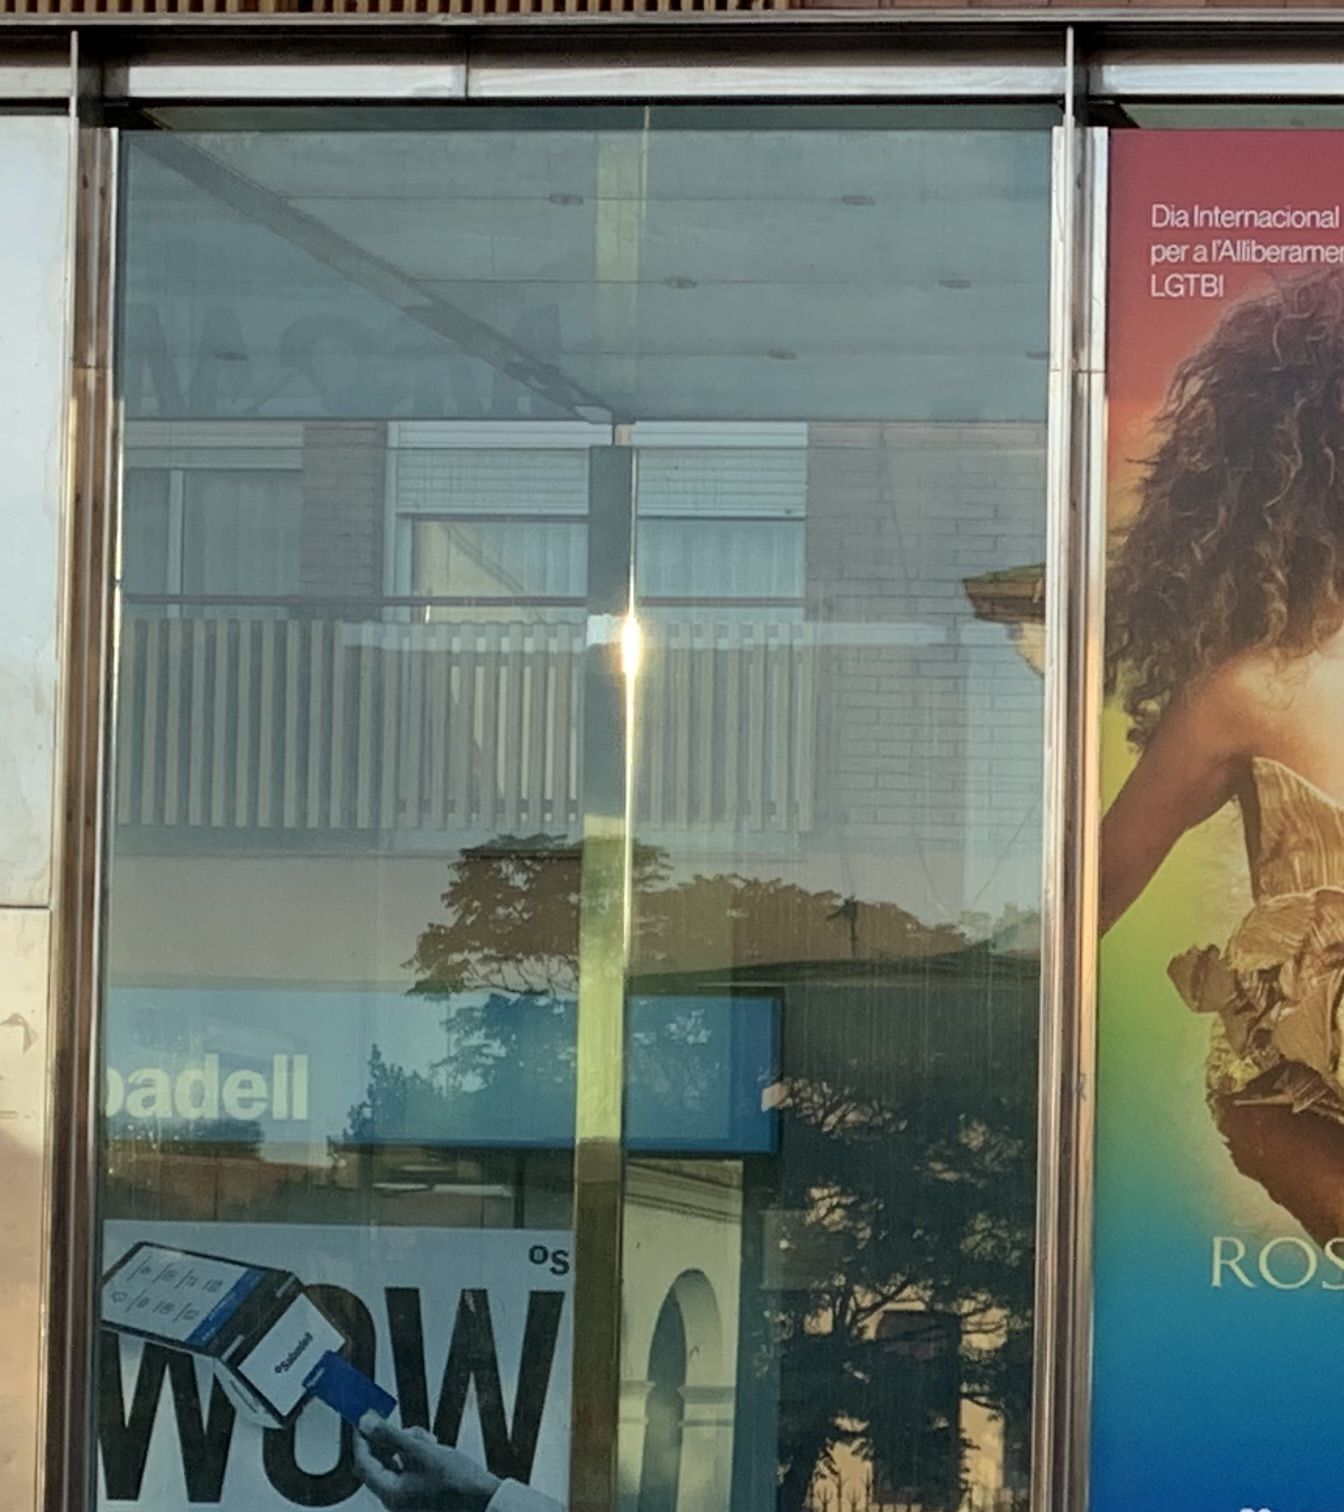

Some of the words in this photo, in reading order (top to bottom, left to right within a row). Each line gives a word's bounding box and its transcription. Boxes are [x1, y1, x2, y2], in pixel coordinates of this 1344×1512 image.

[1151, 204, 1189, 228] Dia
[1193, 204, 1340, 228] Internacional
[1151, 242, 1189, 265] per
[1192, 246, 1208, 263] a
[1151, 273, 1223, 297] LGTBI
